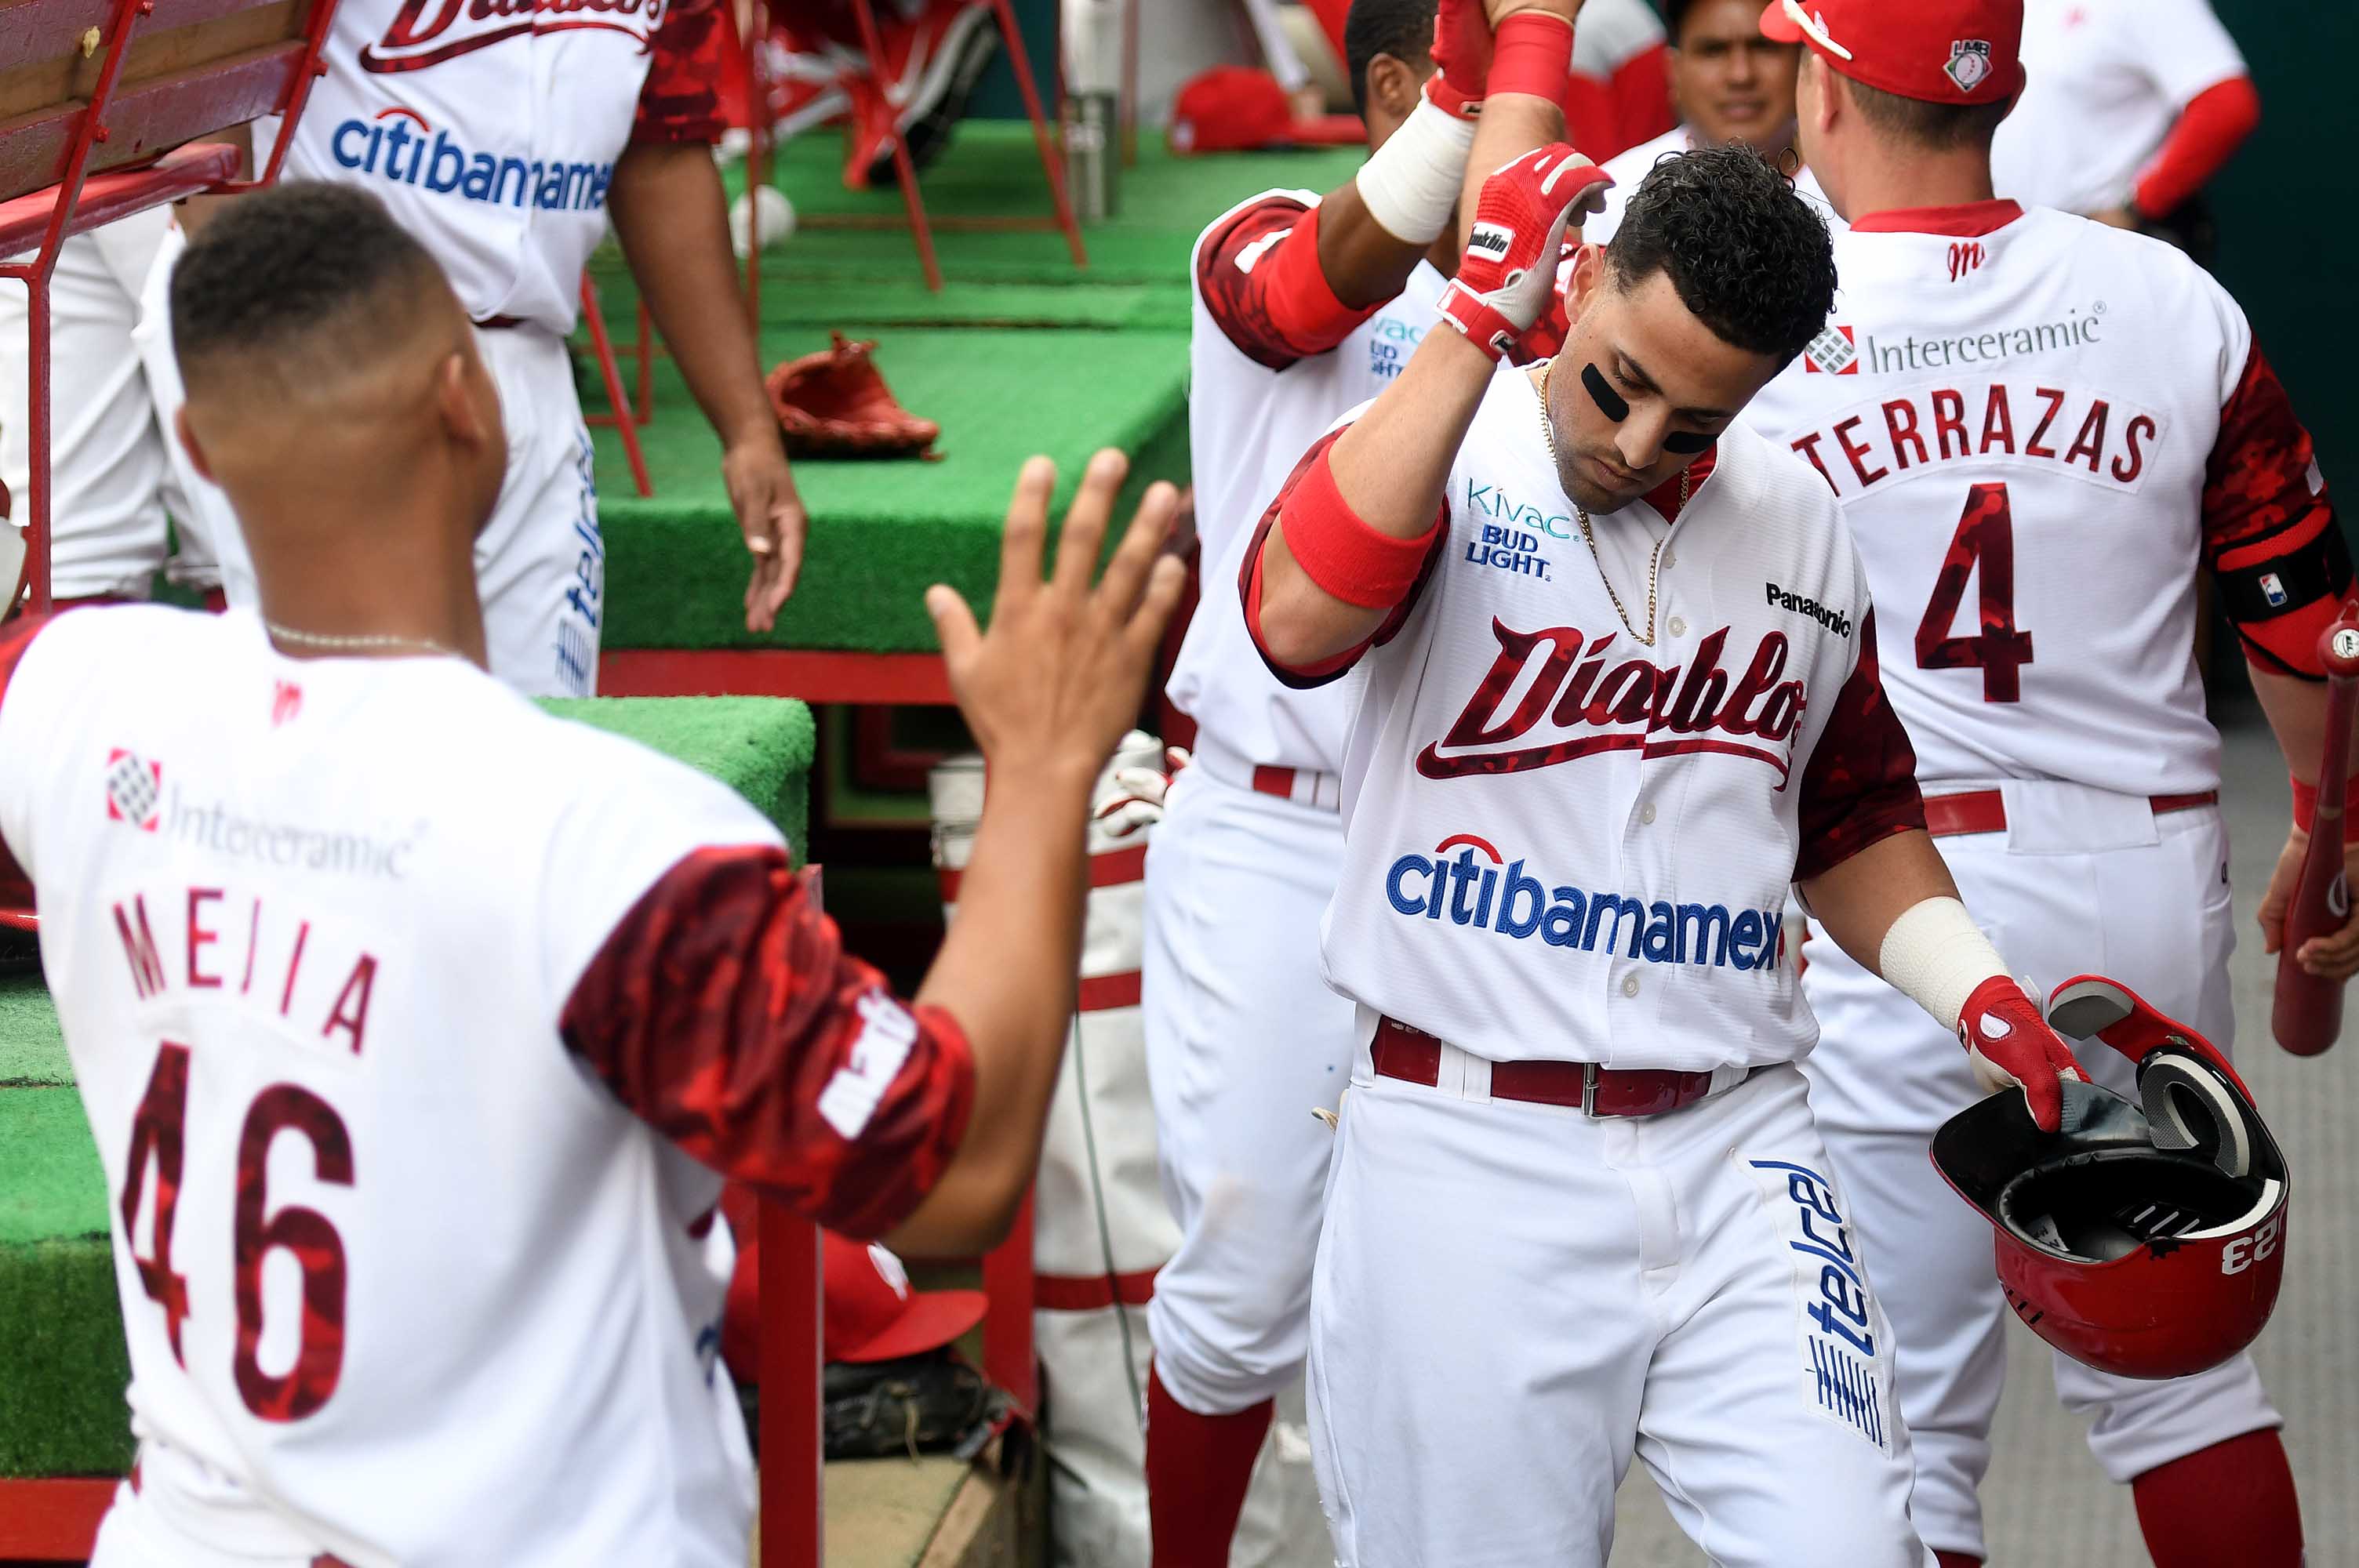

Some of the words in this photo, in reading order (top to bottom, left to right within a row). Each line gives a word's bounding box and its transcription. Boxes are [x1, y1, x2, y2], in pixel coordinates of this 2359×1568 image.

[1950, 39, 1991, 57] LMB
[1867, 308, 2102, 375] Interceramic
[1790, 383, 2156, 498] TERRAZAS
[1465, 542, 1550, 579] LIGHT
[1481, 523, 1539, 553] BUD
[1765, 581, 1852, 639] Panasonic
[1914, 482, 2034, 702] 4
[1386, 847, 1783, 971] citibanamex
[120, 1039, 355, 1423] 46
[1749, 1160, 1875, 1357] telcel
